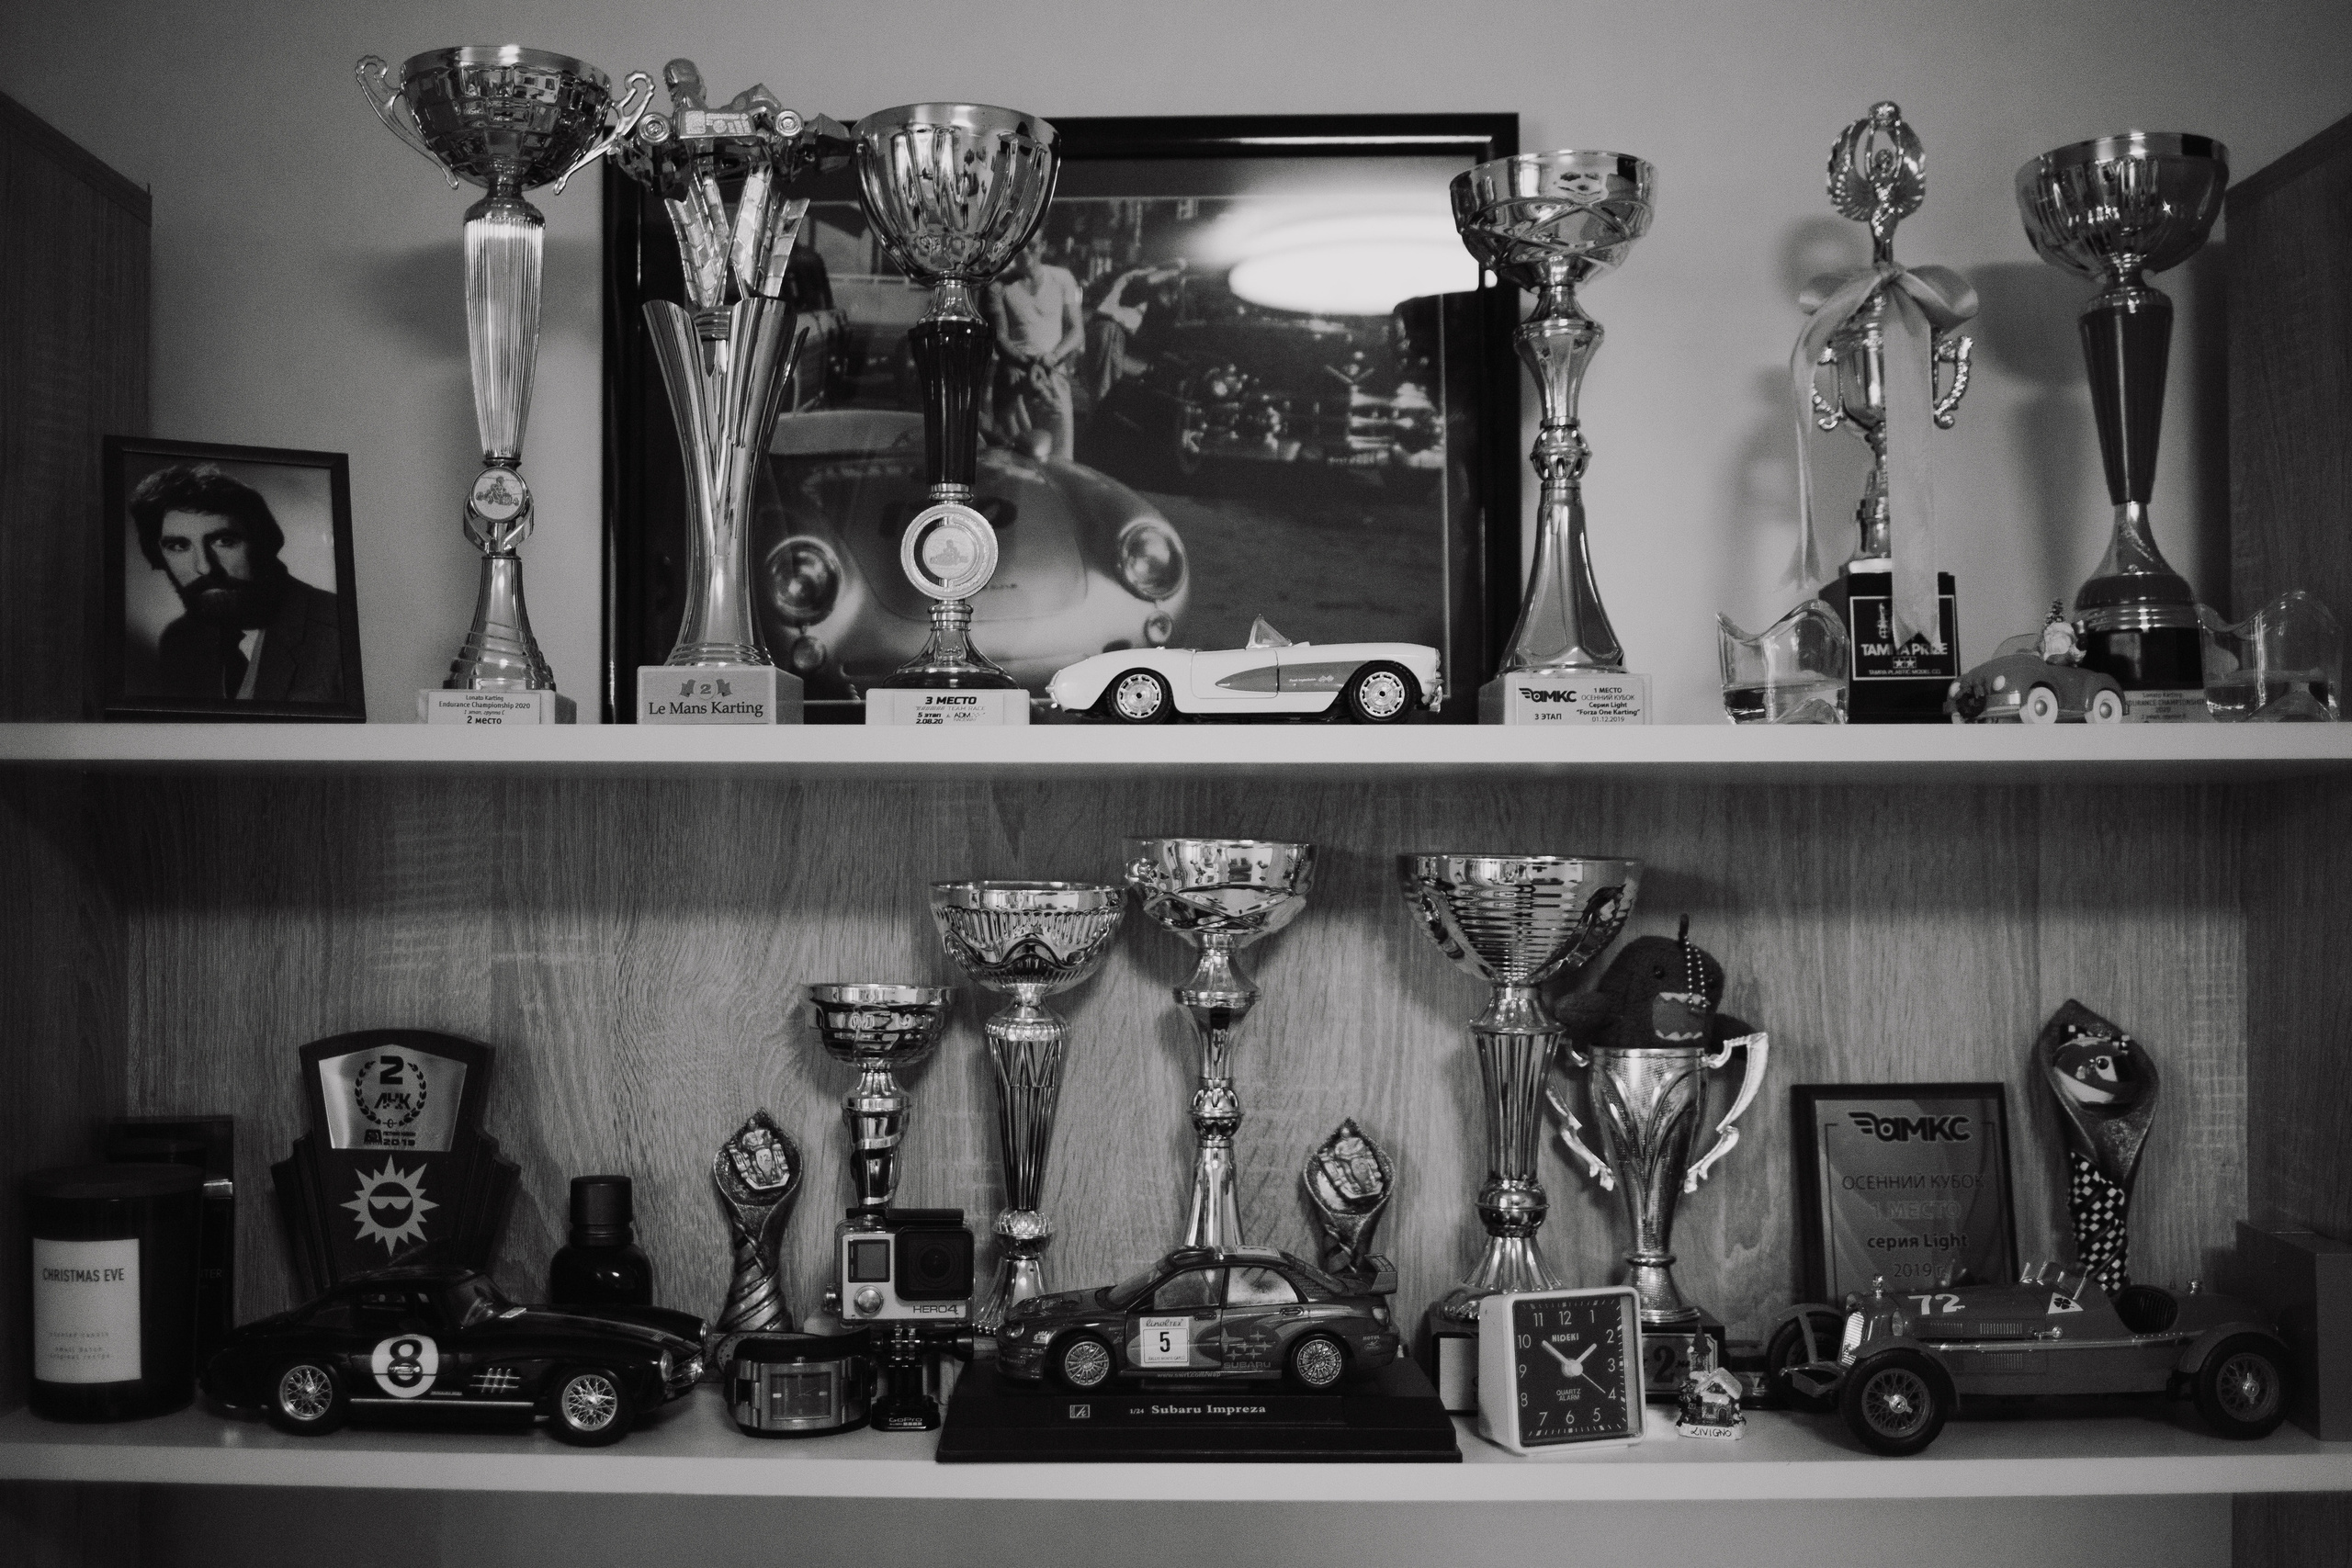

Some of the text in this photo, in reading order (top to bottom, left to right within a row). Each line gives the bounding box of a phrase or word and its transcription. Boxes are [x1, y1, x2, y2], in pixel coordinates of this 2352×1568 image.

[699, 683, 712, 694] 2
[471, 701, 514, 709] Championship
[925, 696, 978, 705] 3 МЕСТО
[649, 701, 764, 717] Le Mans Karting
[467, 716, 473, 724] 2
[379, 1055, 405, 1085] 2
[383, 1138, 416, 1146] 2019
[1841, 1173, 1984, 1190] ОСЕННИЙ КУБОК
[1889, 1201, 1962, 1220] МЕСТО
[1867, 1232, 1969, 1251] серия Light
[42, 1268, 125, 1282] CHRISTMAS EVE
[1894, 1263, 1932, 1278] 2019
[912, 1305, 957, 1314] HERO4
[1907, 1293, 1966, 1316] 72
[1532, 1312, 1544, 1327] 11
[1558, 1310, 1572, 1325] 12
[1589, 1309, 1595, 1324] 1
[1159, 1331, 1170, 1352] 5
[1517, 1334, 1532, 1348] 10
[1551, 1332, 1579, 1342] HIDEKI
[1606, 1329, 1614, 1344] 2
[387, 1338, 423, 1388] 8
[1608, 1358, 1615, 1372] 3
[1653, 1345, 1676, 1382] 2
[1519, 1364, 1527, 1379] 9
[1556, 1388, 1581, 1396] QUARTZ
[1558, 1393, 1580, 1402] ALARM
[1608, 1387, 1616, 1400] 4
[1520, 1393, 1528, 1407] 8
[1151, 1404, 1202, 1415] Subaru
[1206, 1404, 1266, 1416] Impreza
[1566, 1410, 1575, 1425] 6
[1592, 1407, 1601, 1422] 5
[1538, 1411, 1548, 1427] 7
[1690, 1425, 1732, 1438] LIVIGNO
